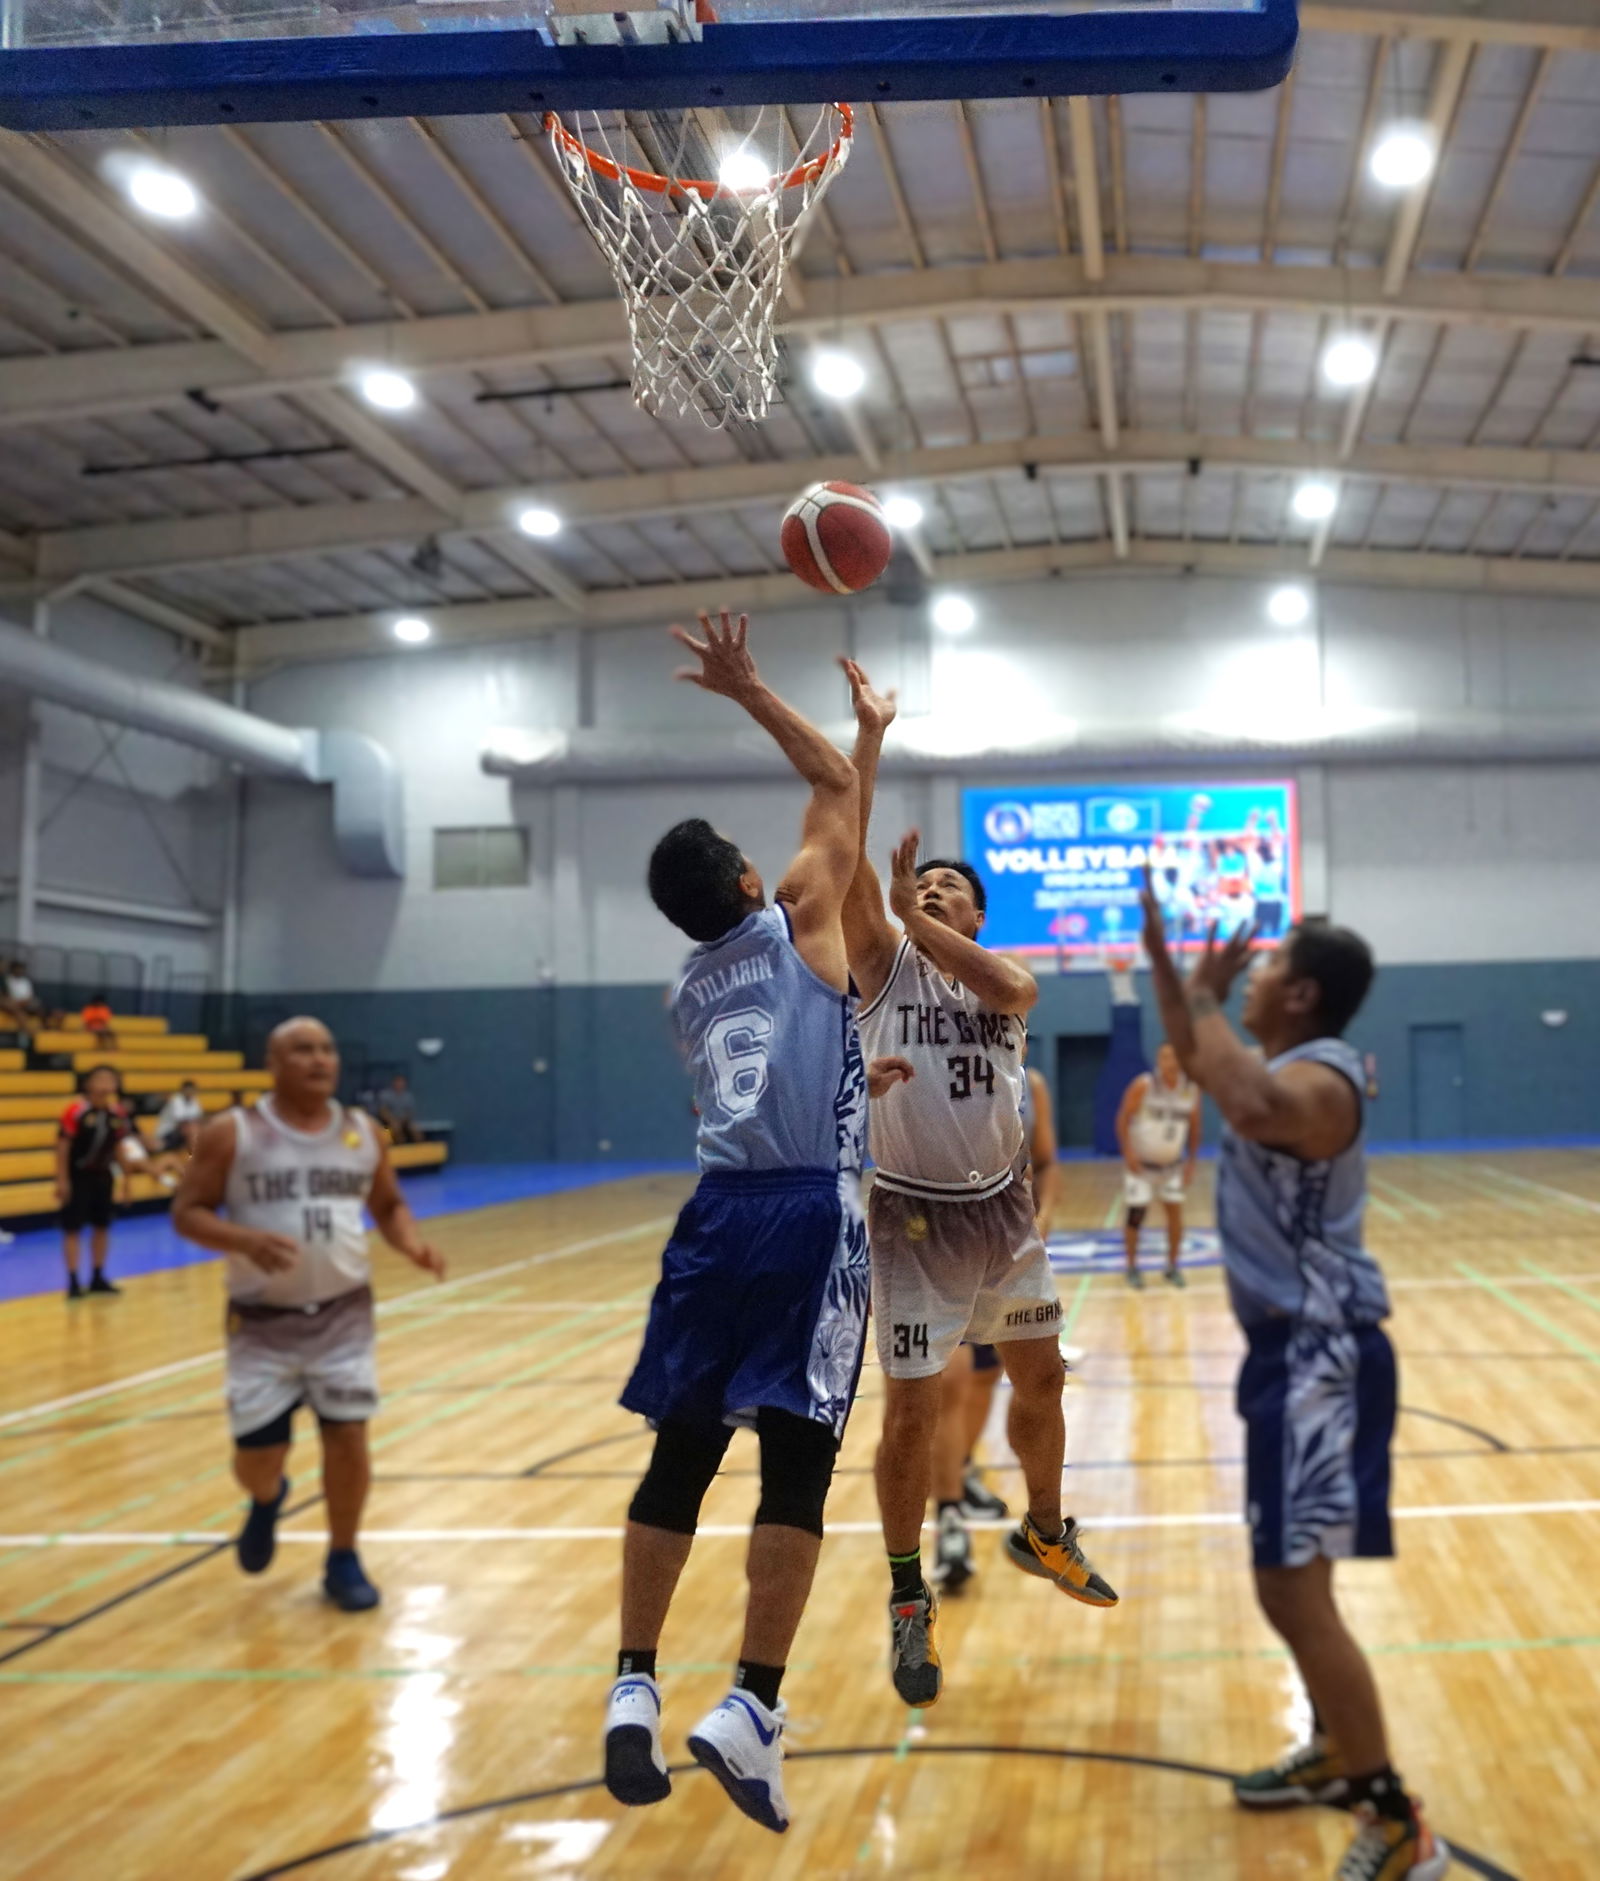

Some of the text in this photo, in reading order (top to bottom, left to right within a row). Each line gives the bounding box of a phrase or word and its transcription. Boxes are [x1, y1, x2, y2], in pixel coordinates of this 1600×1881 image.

[687, 953, 774, 1007] VILLARIN
[897, 1003, 1015, 1051] THE GME
[704, 1005, 774, 1118] 6
[947, 1054, 995, 1100] 34
[244, 1168, 299, 1202] THE
[893, 1322, 929, 1359] 34
[1004, 1309, 1031, 1326] THE
